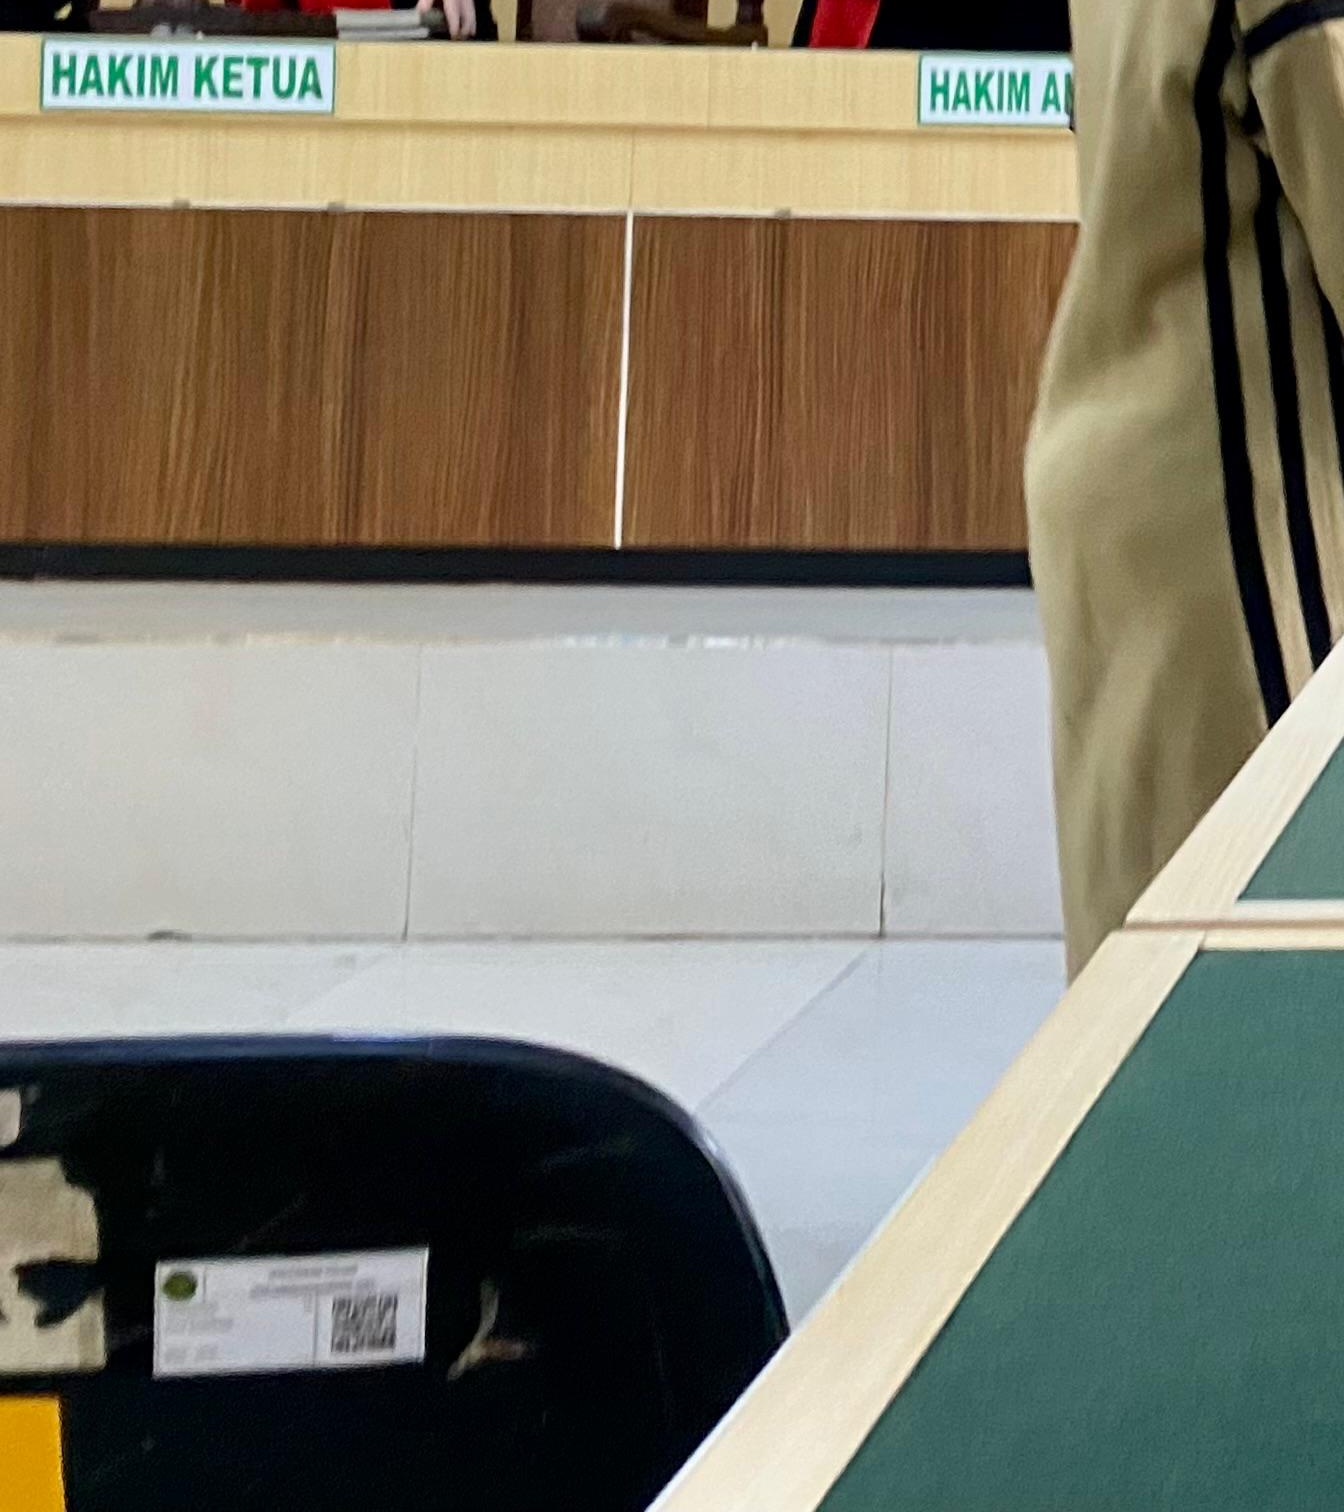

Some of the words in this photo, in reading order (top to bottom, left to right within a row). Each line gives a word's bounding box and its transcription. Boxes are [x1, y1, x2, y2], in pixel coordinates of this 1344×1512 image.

[51, 53, 179, 98] HAKIM
[193, 55, 323, 100] KETUA
[929, 69, 1031, 113] HAKIM
